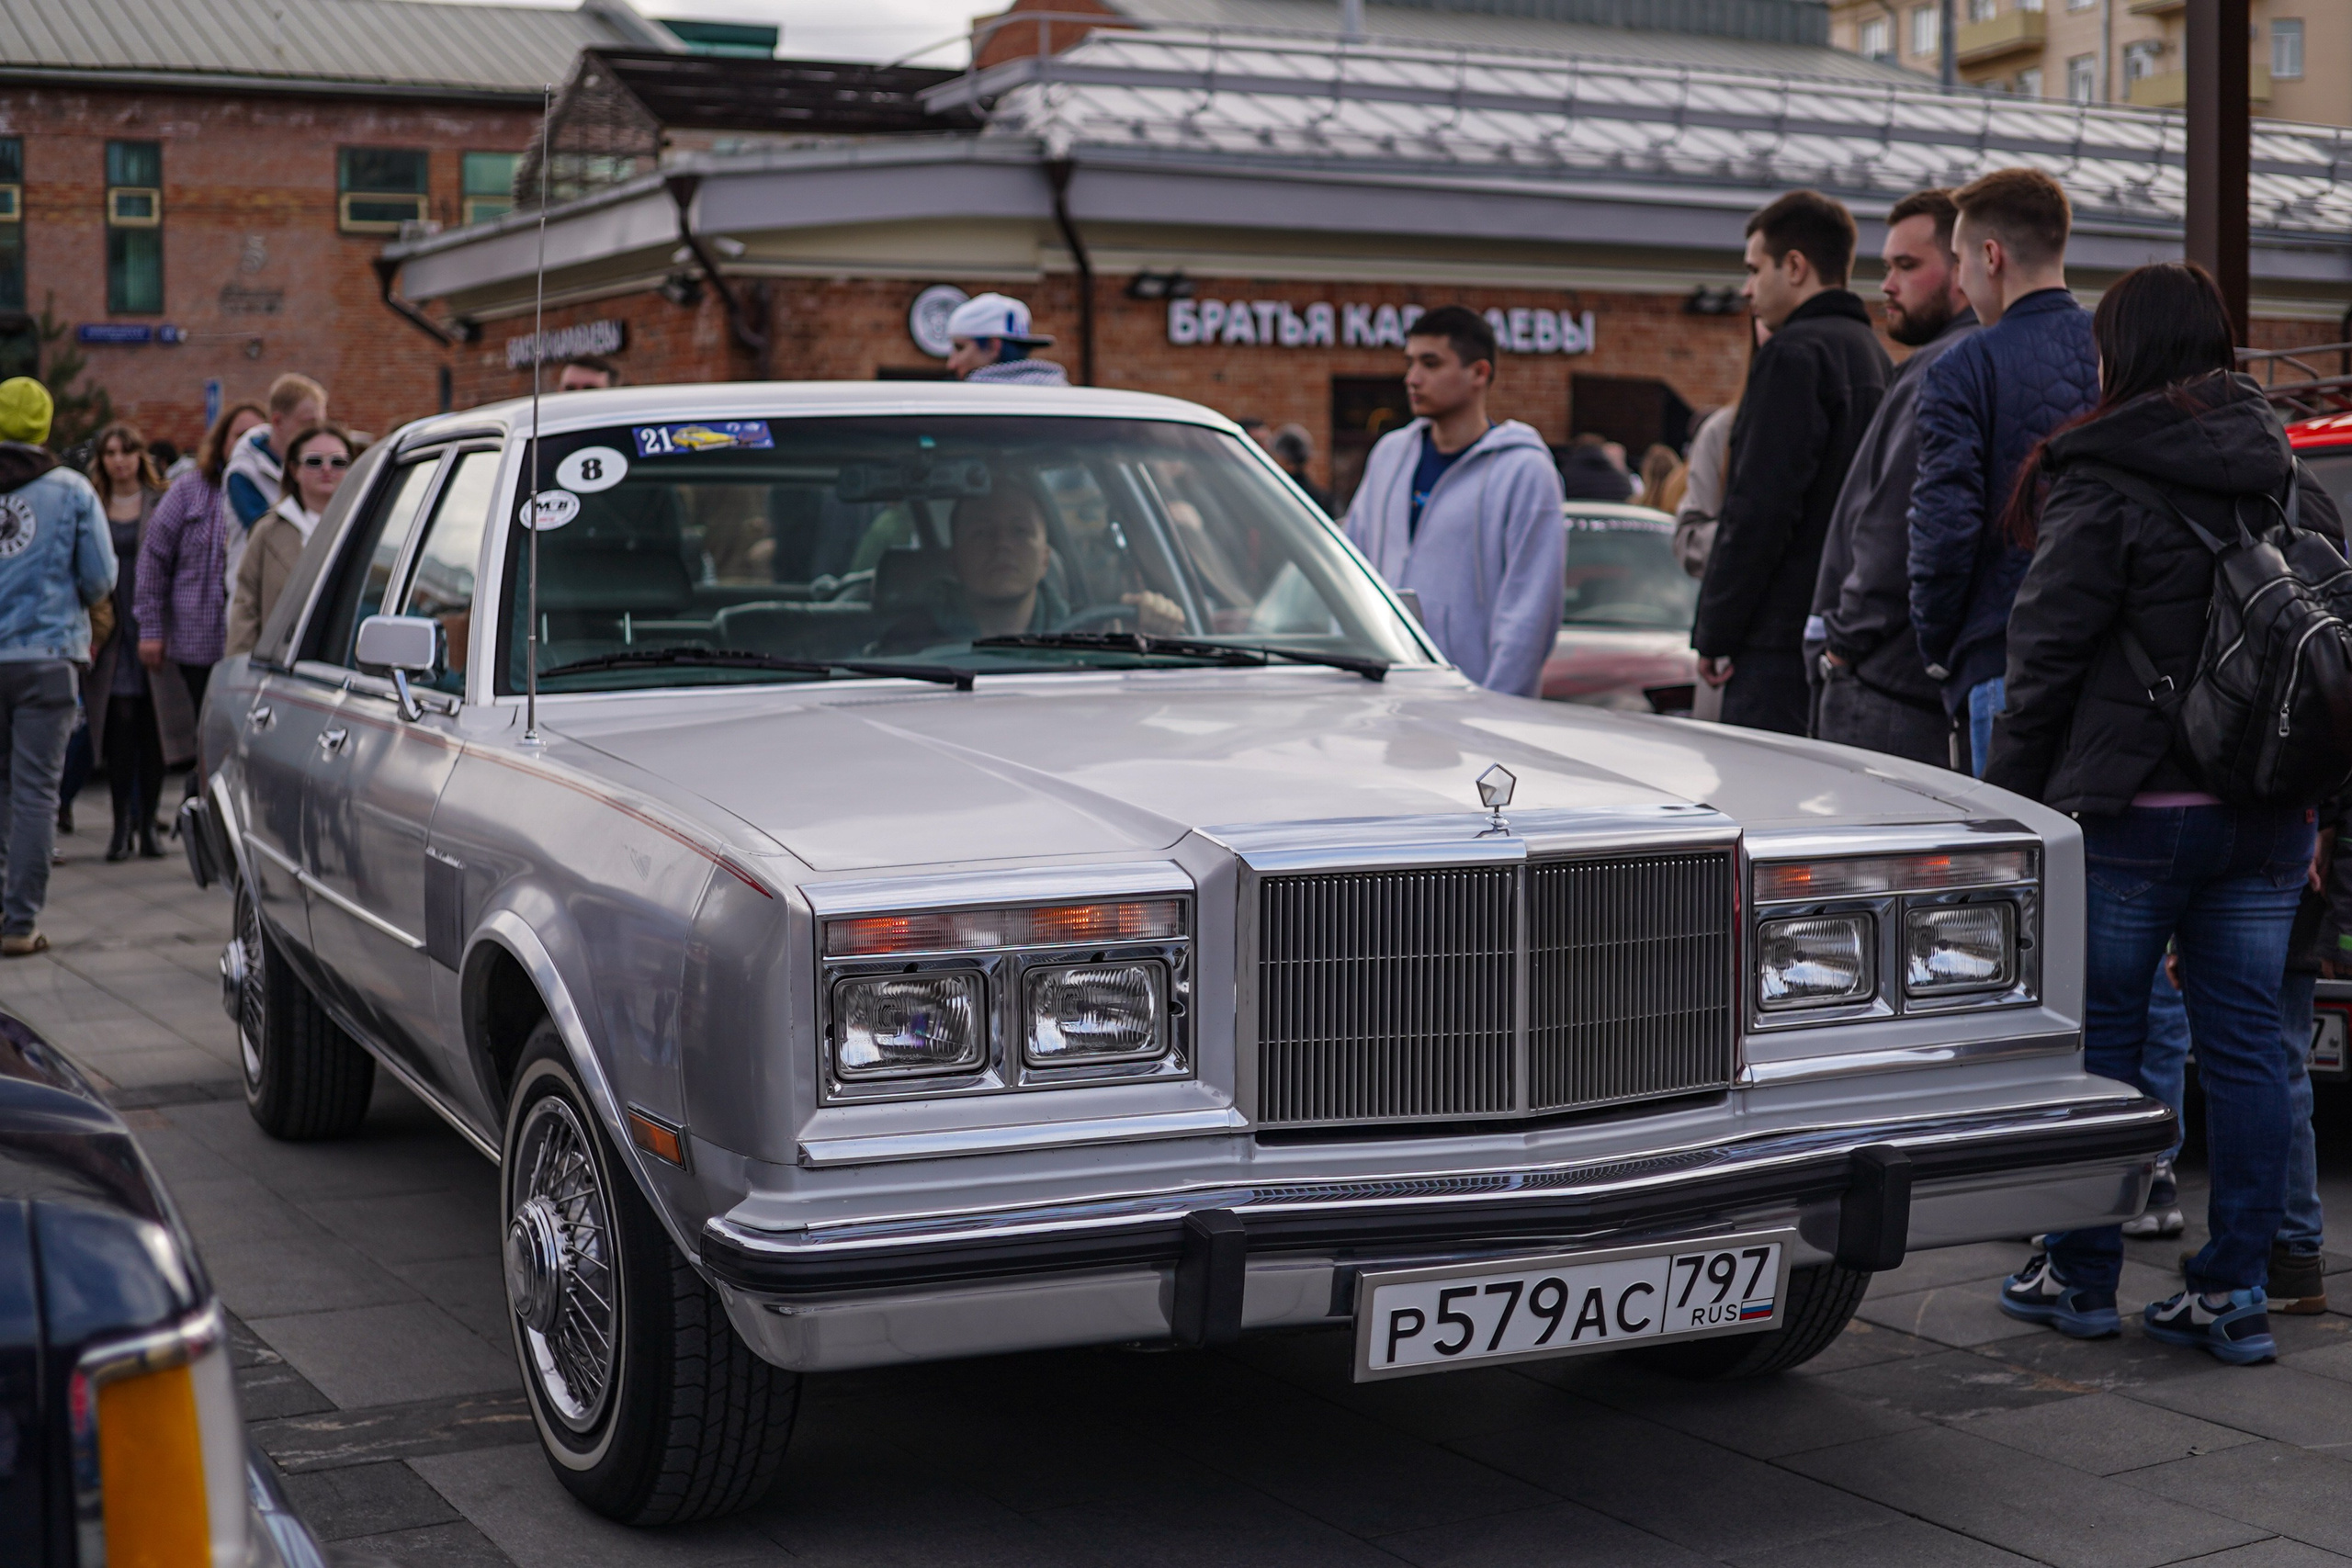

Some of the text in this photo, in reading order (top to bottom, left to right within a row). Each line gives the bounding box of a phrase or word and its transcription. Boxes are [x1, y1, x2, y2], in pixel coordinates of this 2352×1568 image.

[1168, 299, 1596, 355] БРАТЬЯ КАРАЕВЫ
[640, 426, 675, 455] 21
[581, 458, 603, 480] 8
[1386, 1247, 1771, 1363] Р579АС 797
[1690, 1303, 1738, 1327] RUS
